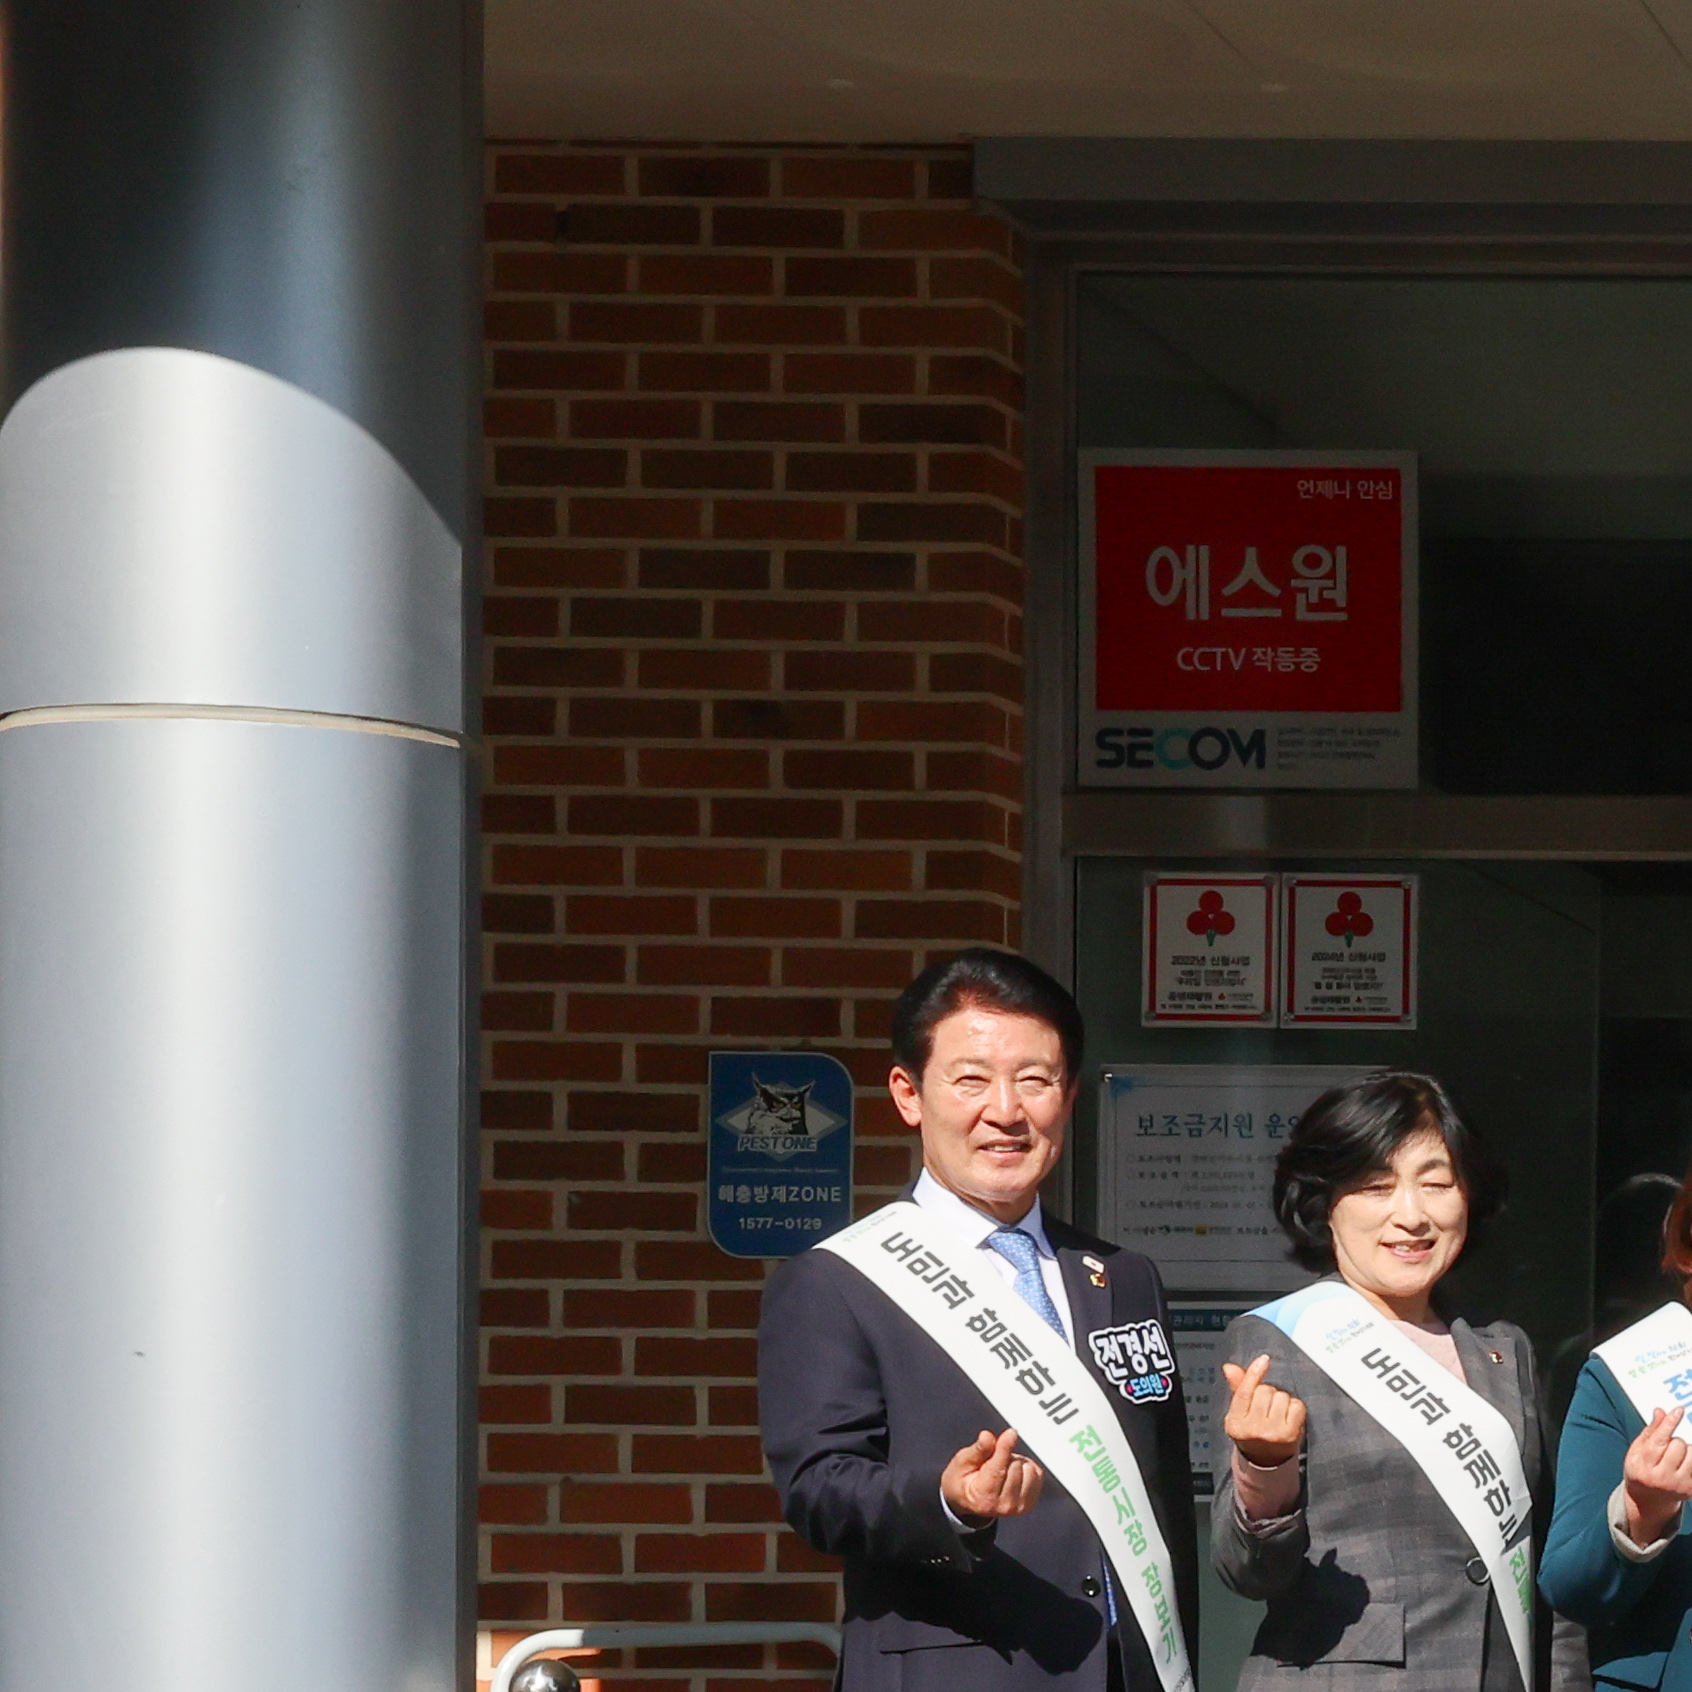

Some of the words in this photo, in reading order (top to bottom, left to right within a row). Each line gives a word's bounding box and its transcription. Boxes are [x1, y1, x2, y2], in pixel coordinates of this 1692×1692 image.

[1357, 479, 1393, 500] 안심
[1145, 544, 1349, 621] 에스원
[1177, 648, 1247, 672] CCTV
[1252, 647, 1321, 673] 작동중
[1095, 727, 1267, 770] SECOM
[1136, 1112, 1254, 1139] 보조금지원
[1095, 1326, 1170, 1378] 전경선
[1130, 1374, 1166, 1397] 도의원
[881, 1231, 974, 1310] 도민과
[965, 1307, 1080, 1426] 함께하는
[1069, 1424, 1148, 1556] 전통시장
[1141, 1560, 1178, 1665] 장보기
[1361, 1347, 1451, 1425] 도민과
[1443, 1423, 1519, 1548] 함께하는
